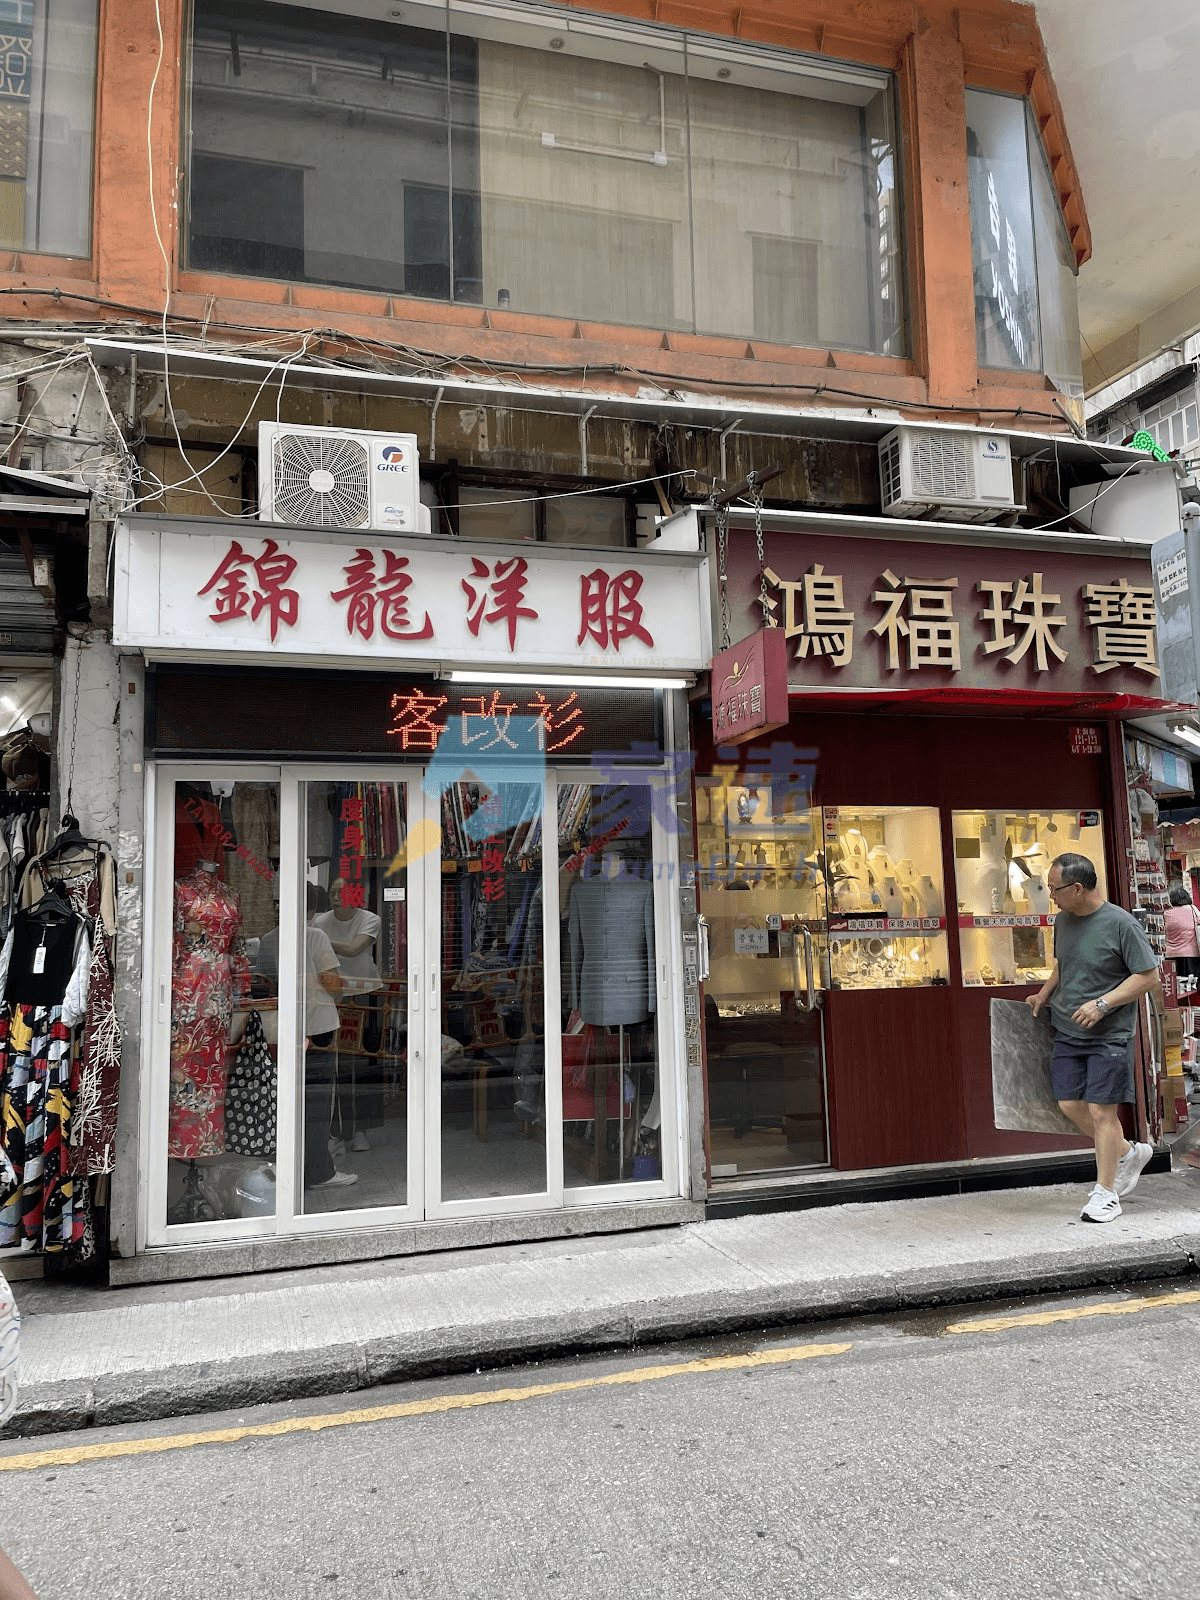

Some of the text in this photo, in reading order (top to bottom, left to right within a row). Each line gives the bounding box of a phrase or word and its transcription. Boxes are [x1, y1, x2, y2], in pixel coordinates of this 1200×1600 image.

[377, 463, 409, 473] GREE
[198, 540, 654, 652] 錦龍洋服
[757, 563, 1161, 678] 鴻福珠寶
[387, 688, 585, 751] 客改衫
[715, 684, 762, 731] 鴻福珠寶
[339, 796, 366, 909] 度身訂做
[480, 794, 506, 902] 精工改衫
[738, 933, 764, 944] 營業中
